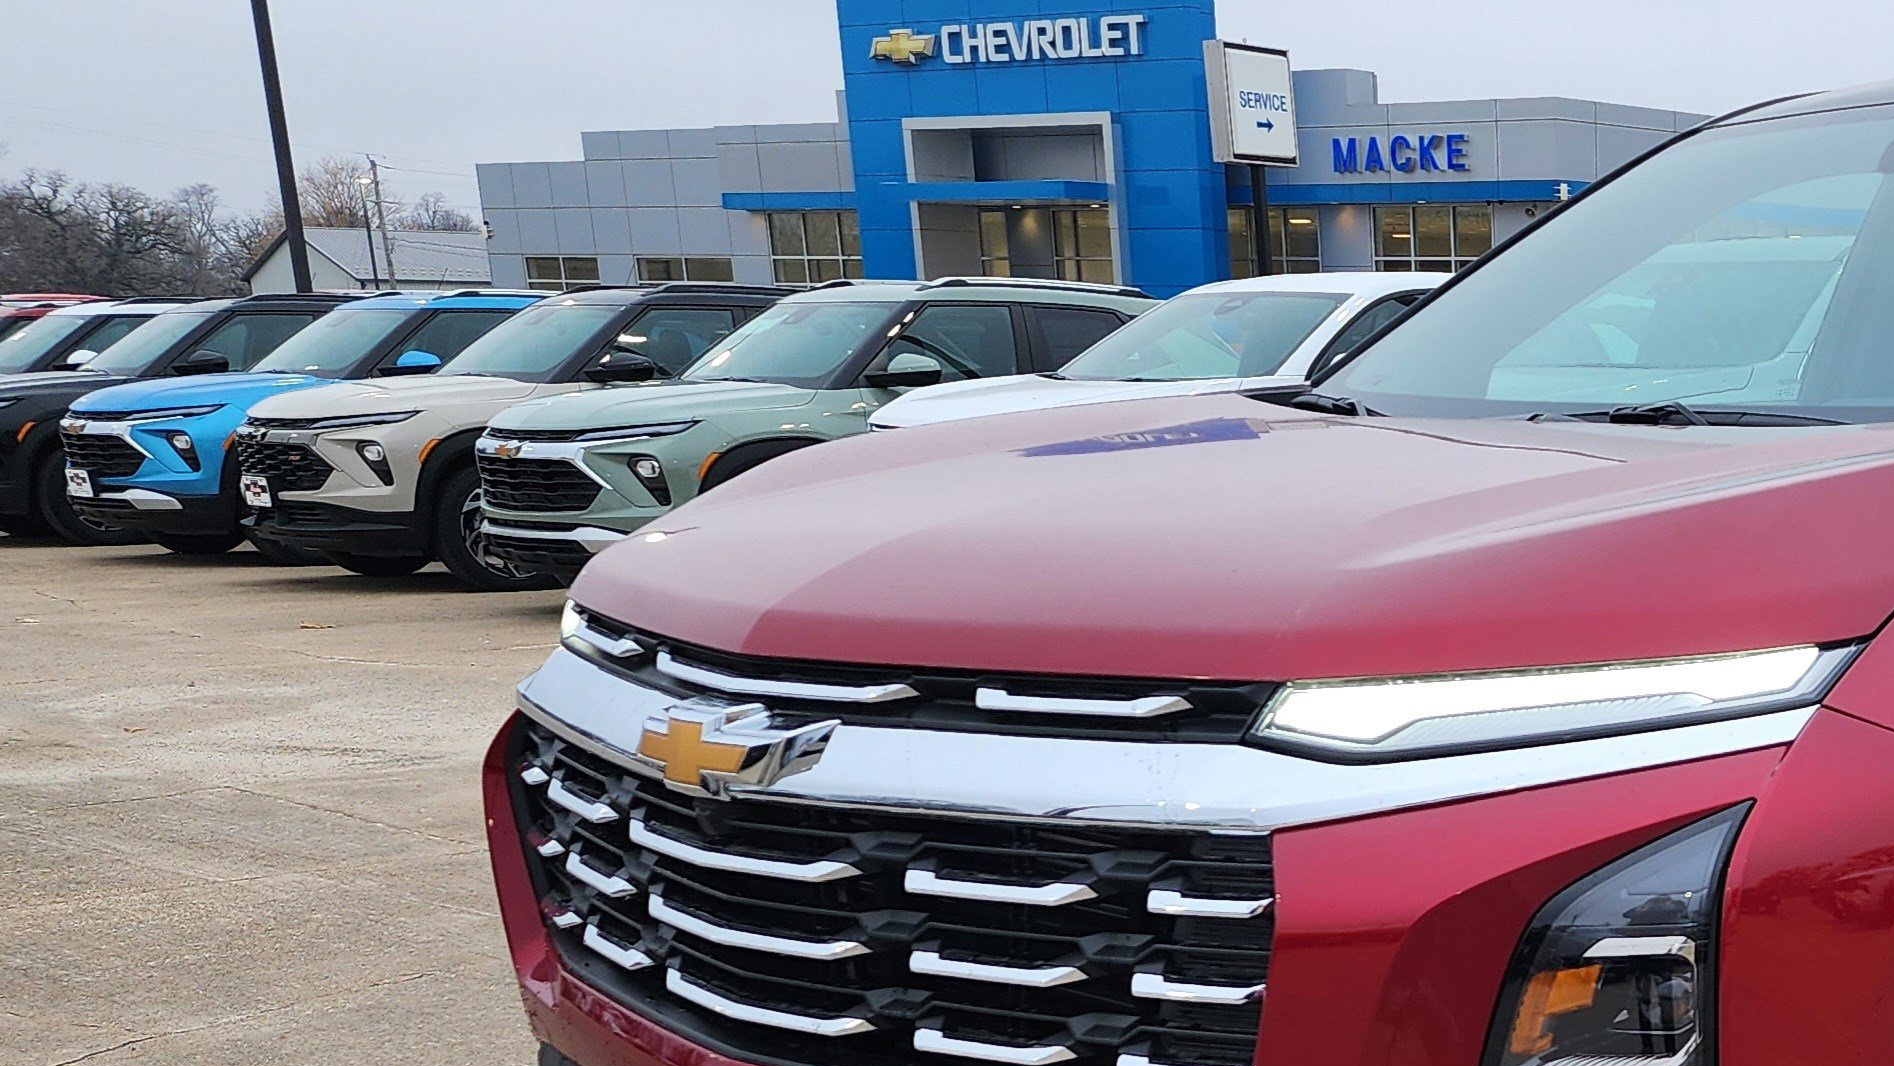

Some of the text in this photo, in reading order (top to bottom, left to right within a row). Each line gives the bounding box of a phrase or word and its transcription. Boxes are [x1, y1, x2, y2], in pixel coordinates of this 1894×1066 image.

[941, 14, 1145, 64] CHEVROLET
[1239, 90, 1288, 112] SERVICE
[1332, 134, 1470, 174] MACKE
